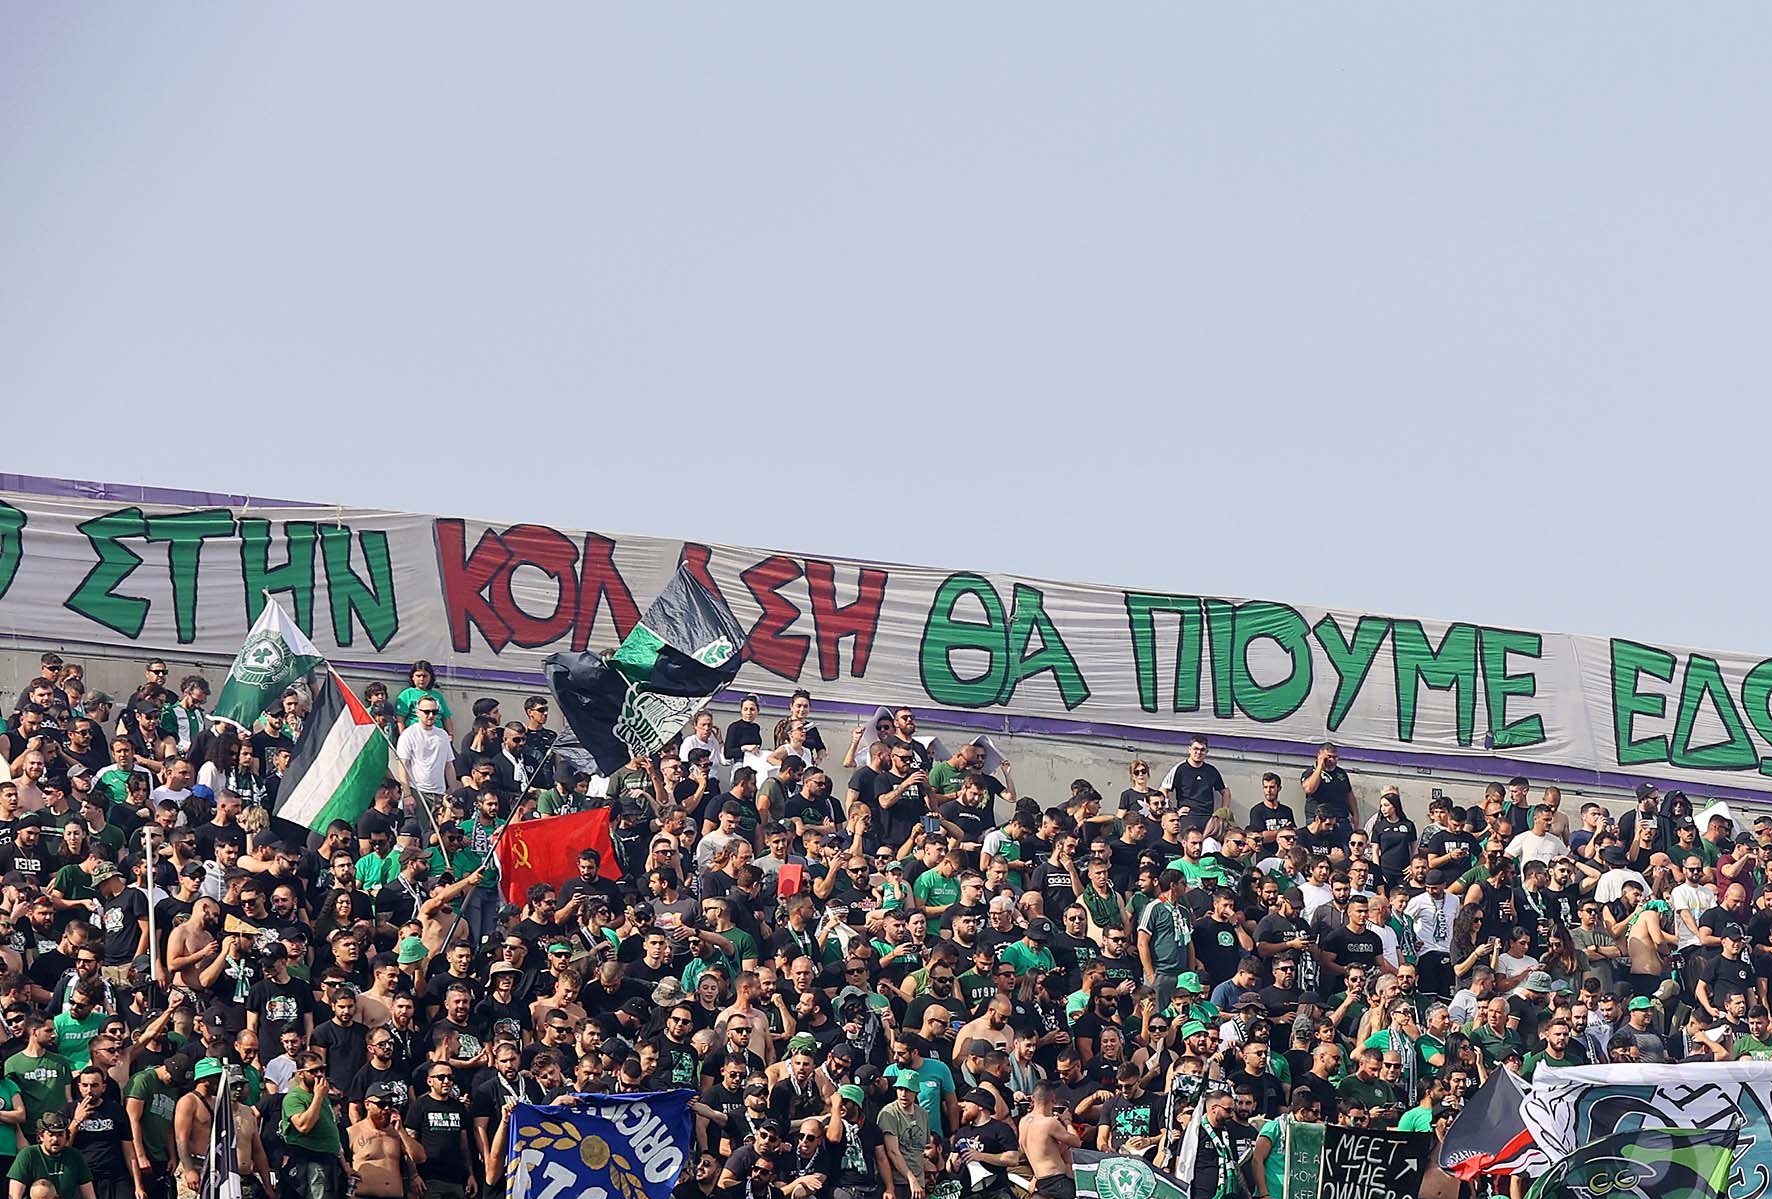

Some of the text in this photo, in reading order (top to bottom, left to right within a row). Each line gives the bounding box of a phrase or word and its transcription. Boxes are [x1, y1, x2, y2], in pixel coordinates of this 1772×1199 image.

[919, 572, 1091, 711] ΘΑ
[1125, 591, 1546, 750] ΠΙΟΥΜΕ
[1335, 1133, 1408, 1165] MEET
[1341, 1160, 1387, 1188] THE
